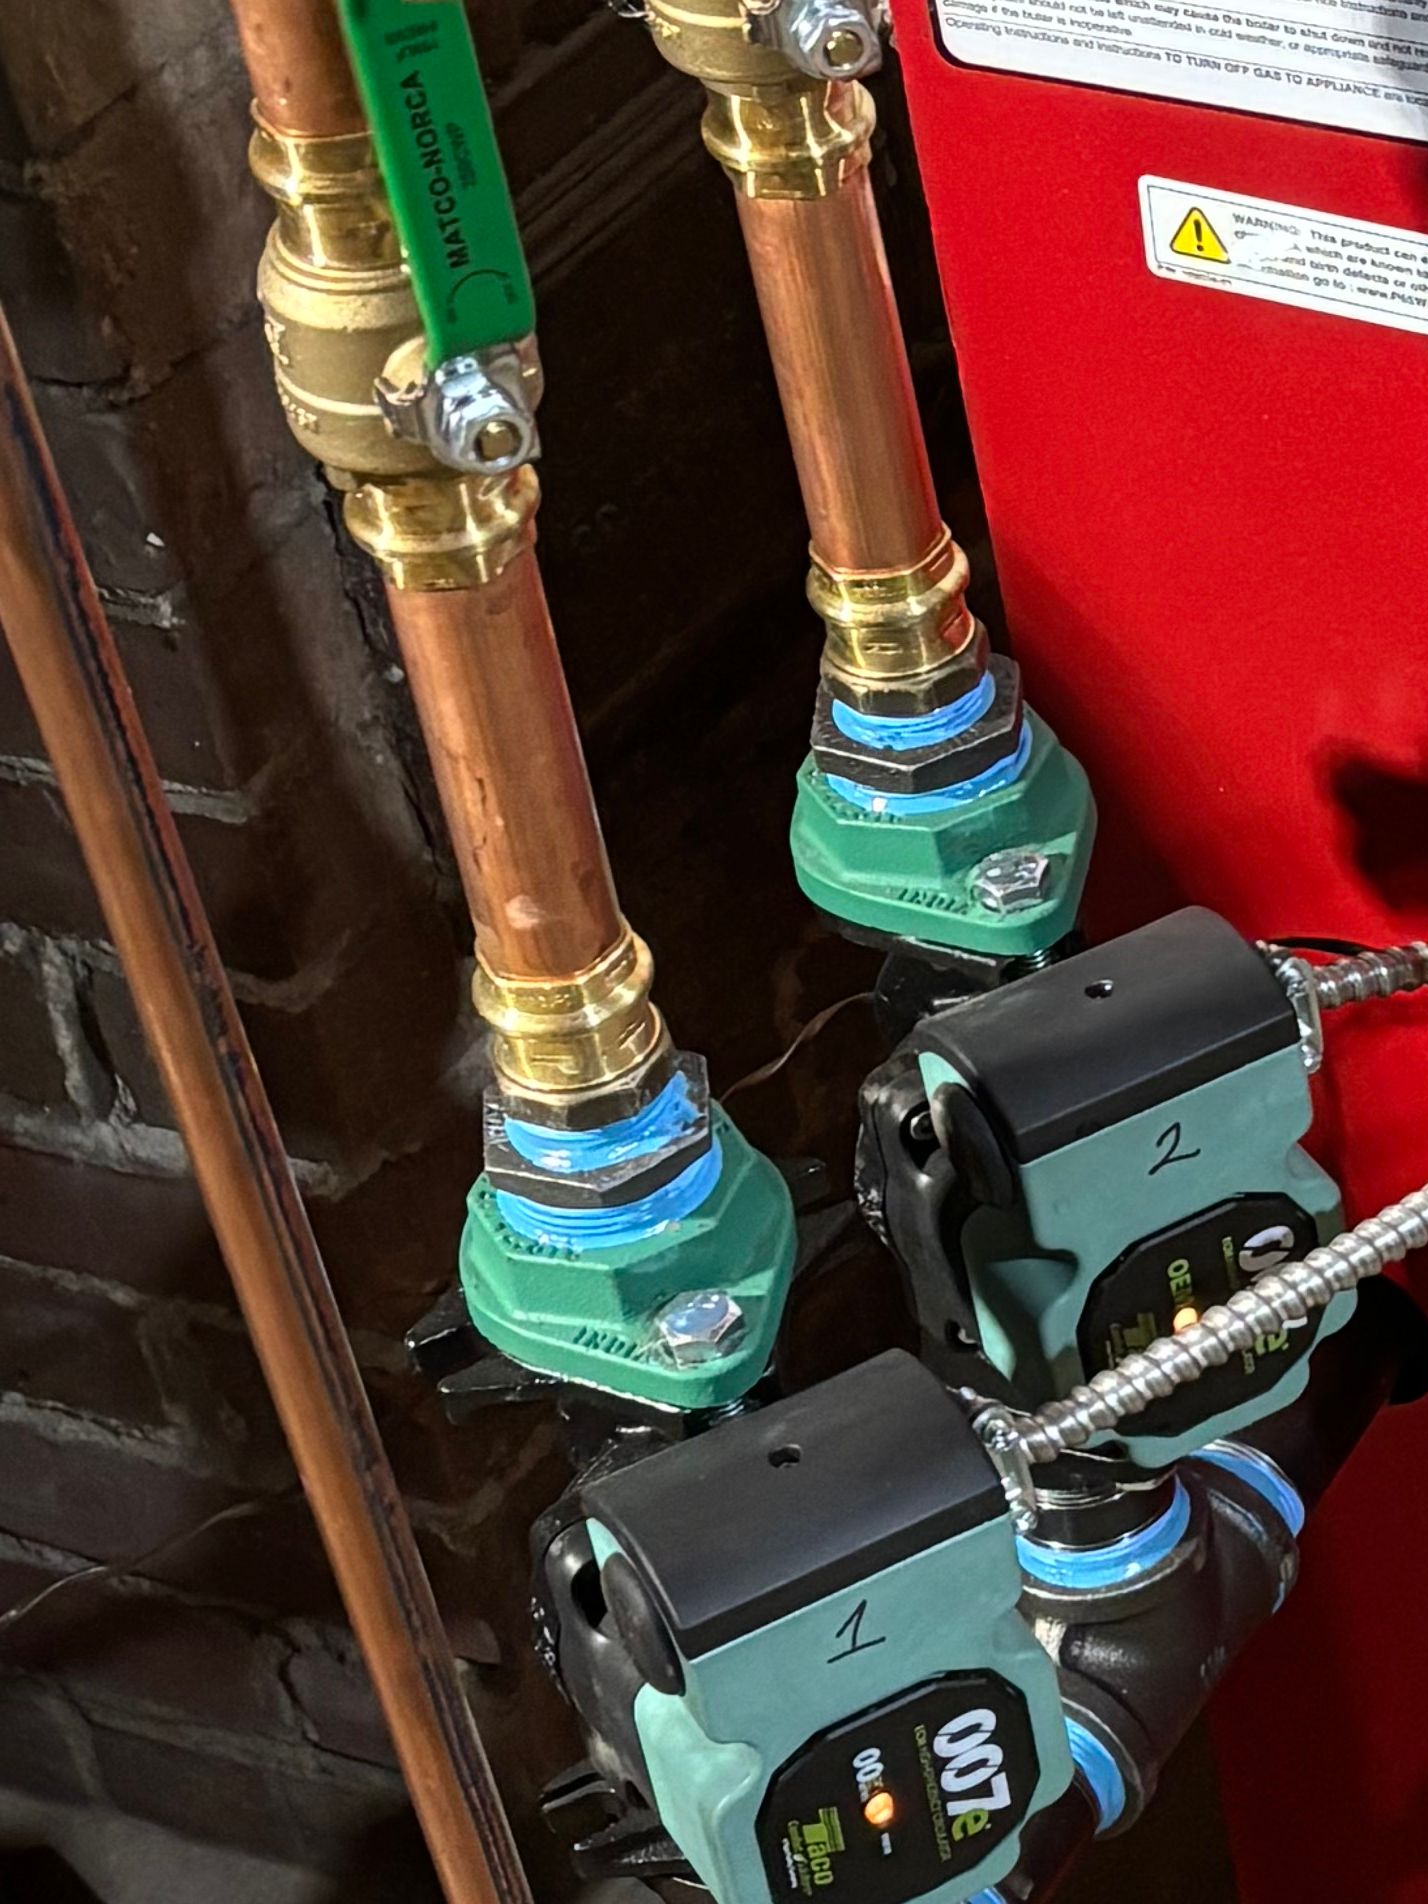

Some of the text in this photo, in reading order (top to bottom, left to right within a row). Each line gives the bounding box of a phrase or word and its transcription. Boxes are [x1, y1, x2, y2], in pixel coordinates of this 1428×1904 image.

[399, 70, 470, 269] MATCO-NORCA
[1306, 242, 1343, 259] which
[1346, 253, 1366, 265] are
[1370, 256, 1412, 275] known
[1416, 267, 1428, 278] to
[1310, 229, 1337, 244] This
[1341, 236, 1390, 258] product
[1394, 250, 1416, 261] can
[1309, 258, 1338, 273] birth
[1342, 265, 1388, 284] defects
[1393, 278, 1405, 288] or
[1313, 275, 1329, 288] go
[1333, 277, 1345, 289] to
[1147, 1124, 1201, 1176] 2
[827, 1599, 887, 1663] 1
[933, 1708, 1011, 1841] 007e
[803, 1807, 845, 1885] Taco
